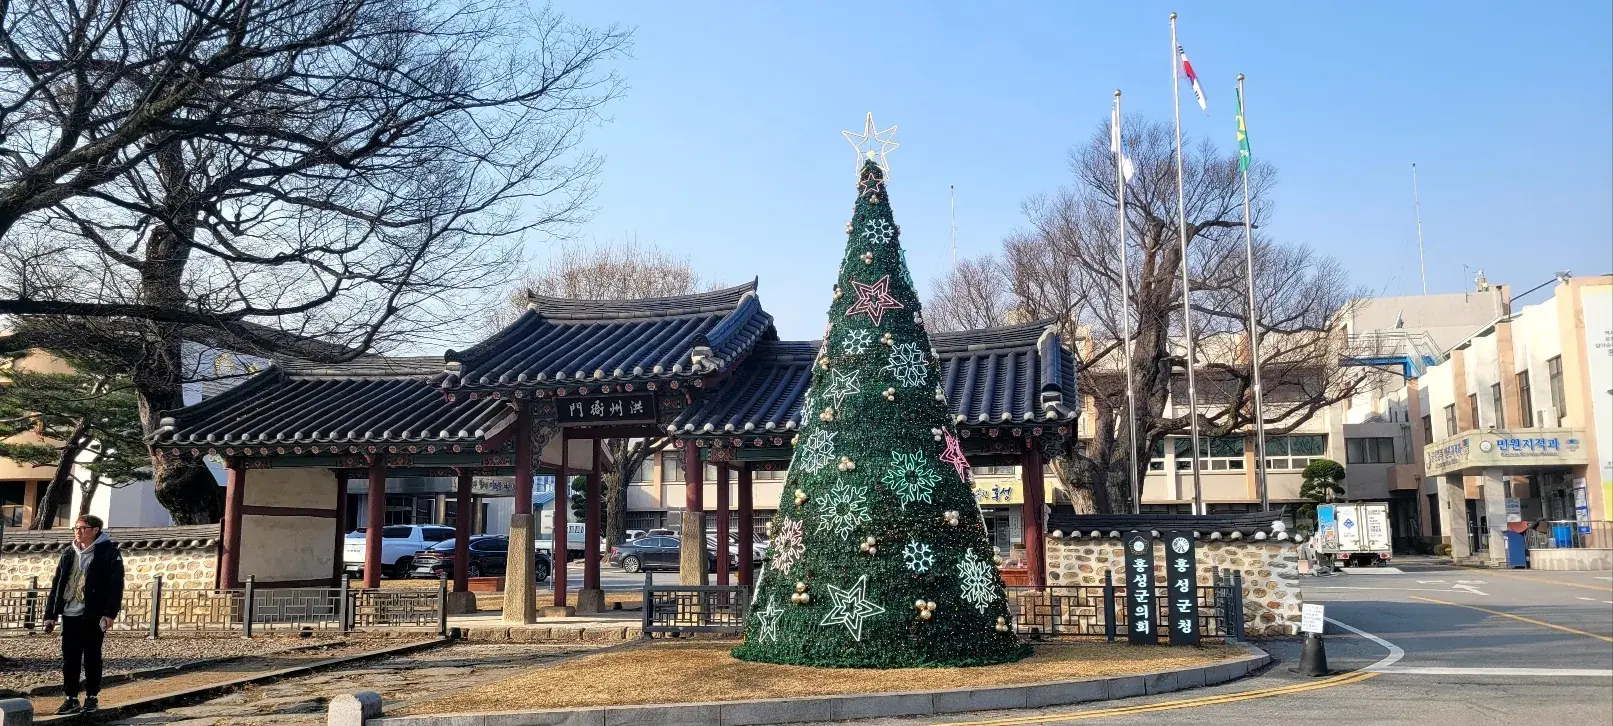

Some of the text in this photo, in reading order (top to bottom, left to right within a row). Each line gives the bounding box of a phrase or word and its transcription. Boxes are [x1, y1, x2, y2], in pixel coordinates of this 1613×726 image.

[1496, 437, 1560, 451] 민원지적과
[992, 484, 1012, 502] 홍성
[1132, 558, 1150, 635] 홍성군의회
[1173, 558, 1193, 634] 홍성군청
